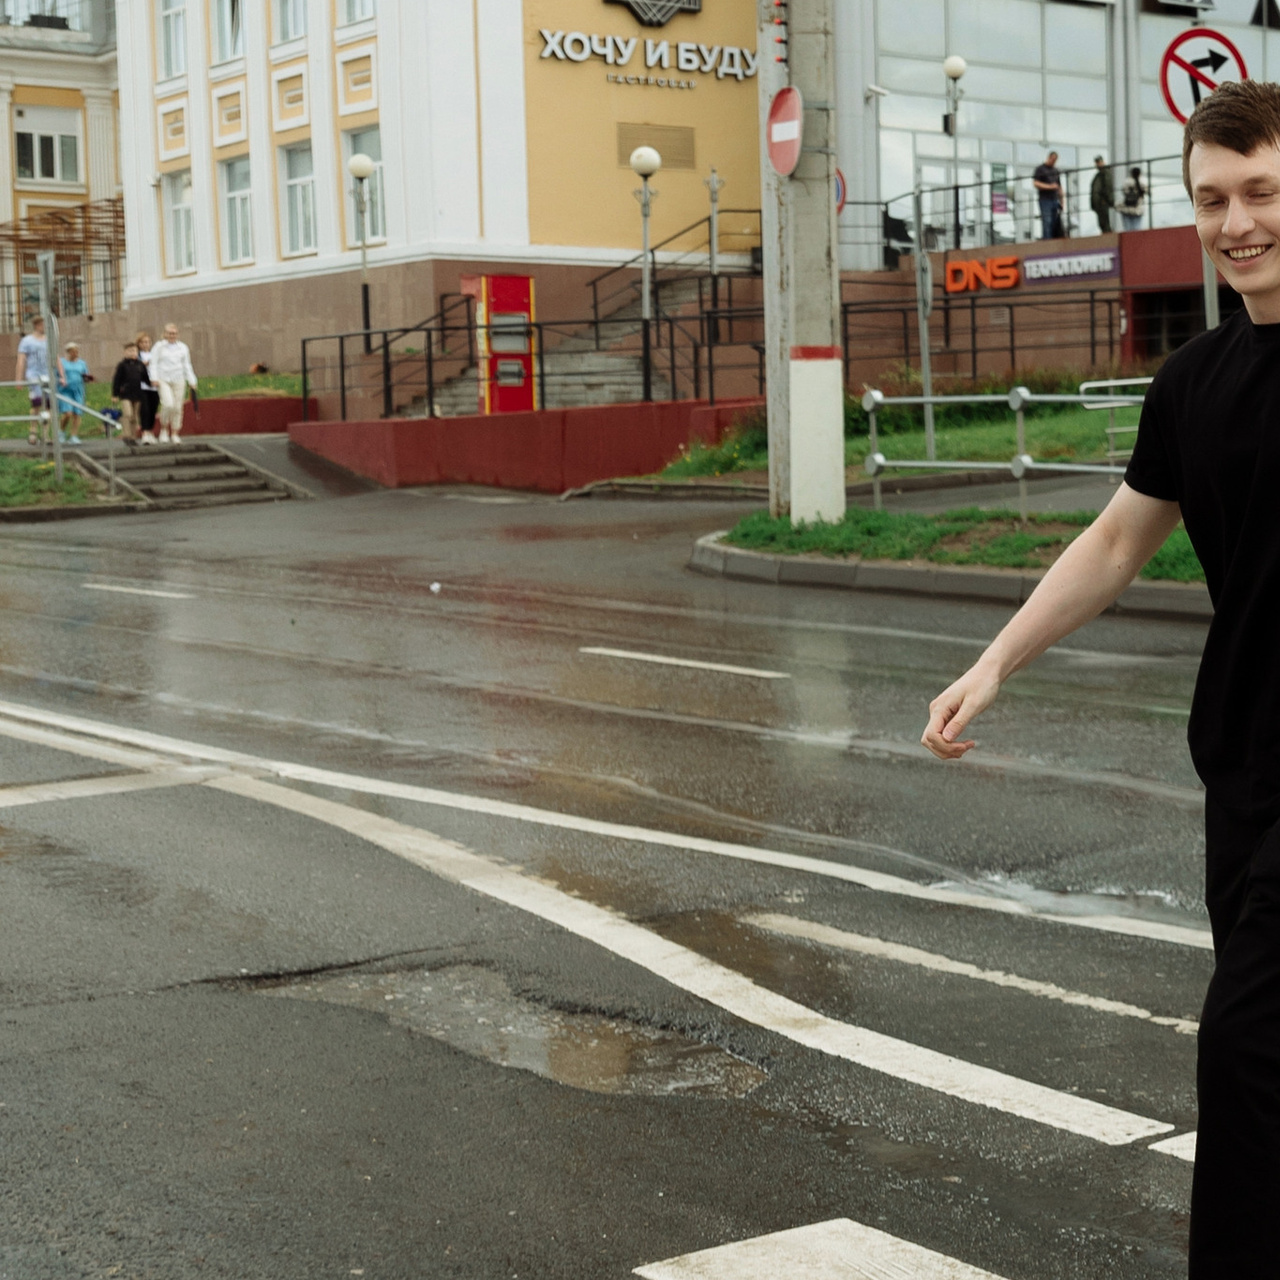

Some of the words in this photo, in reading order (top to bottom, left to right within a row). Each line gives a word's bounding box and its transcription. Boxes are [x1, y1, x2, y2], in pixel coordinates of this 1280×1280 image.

[540, 29, 638, 66] ХОЧУ
[645, 39, 670, 69] И
[677, 42, 758, 81] БУДУ
[607, 73, 697, 90] ГАСТРОБАР
[946, 256, 1019, 292] DNS
